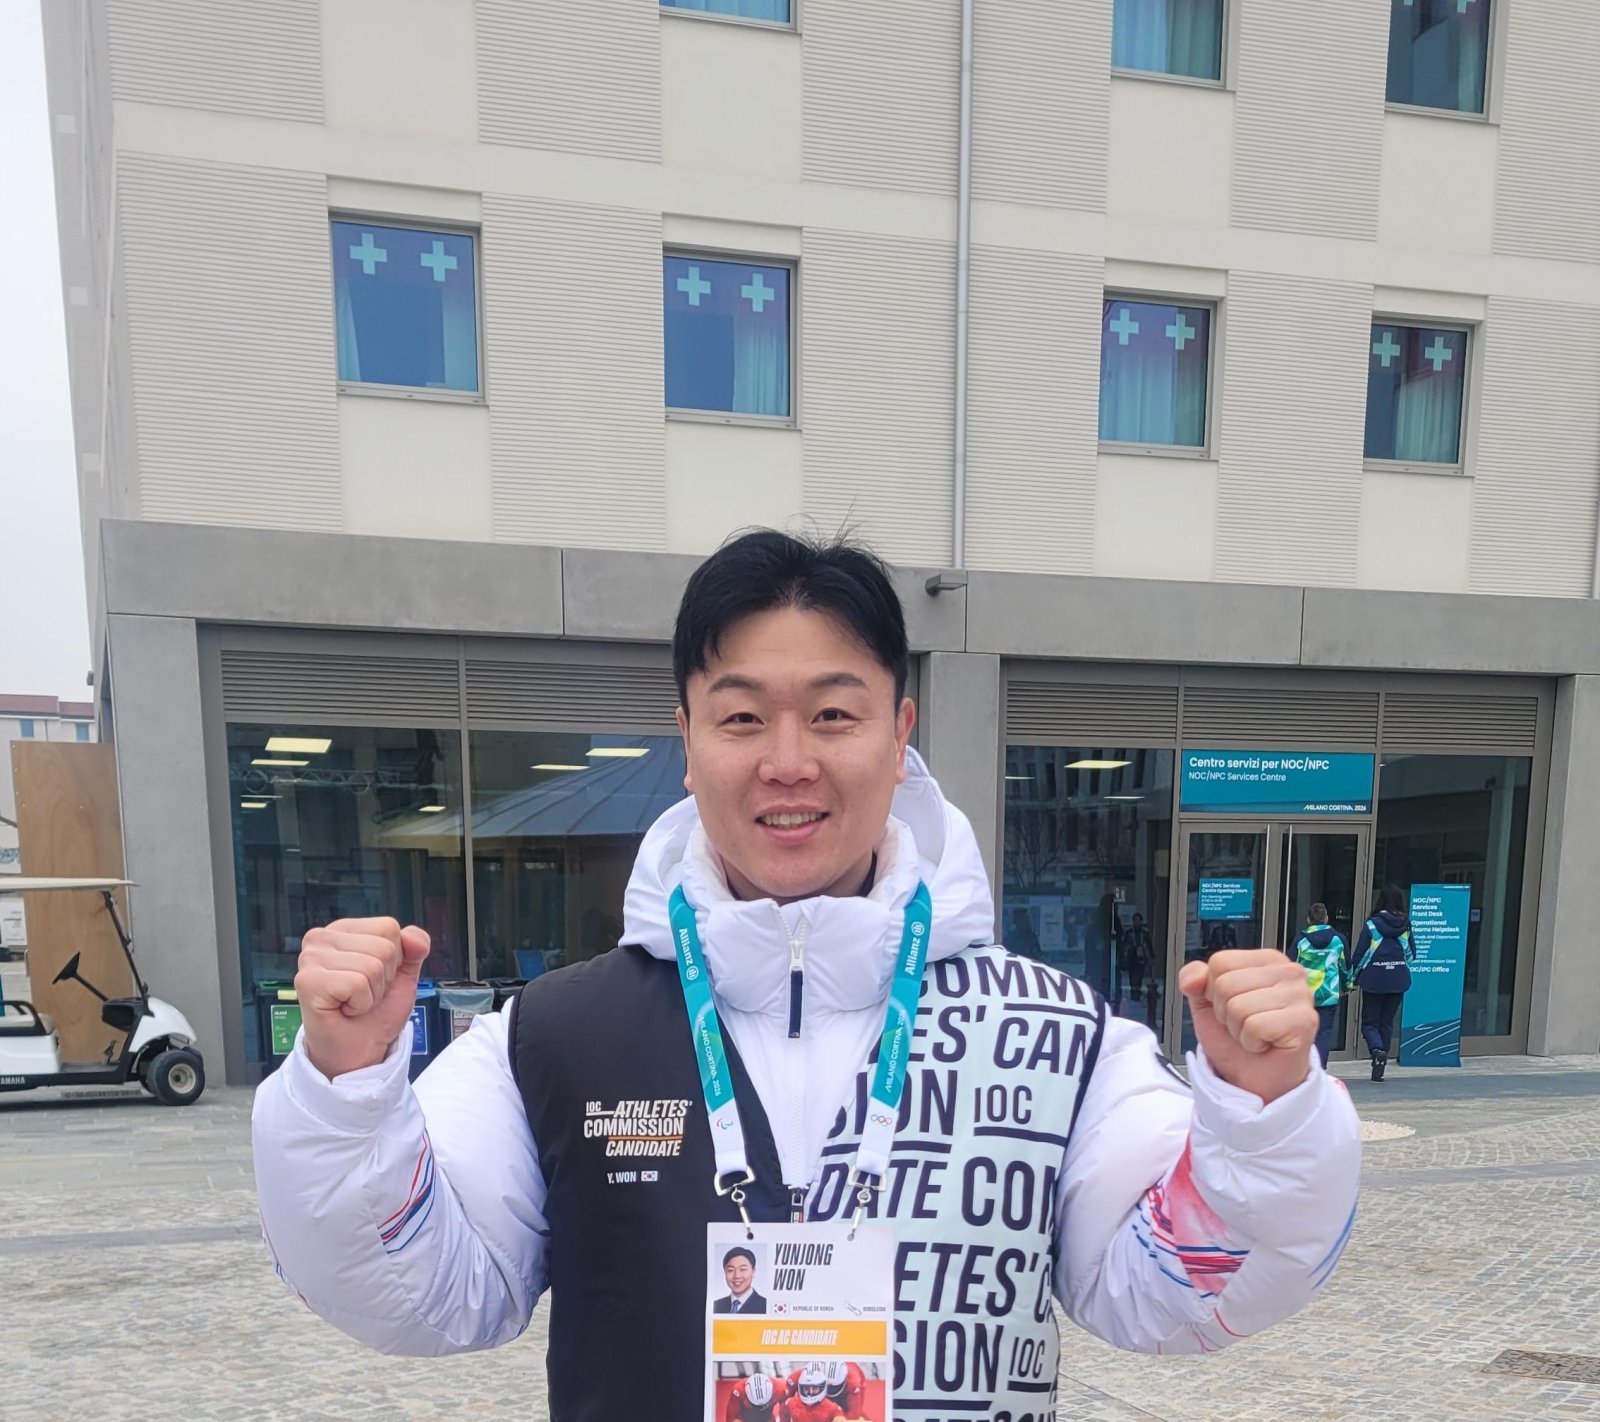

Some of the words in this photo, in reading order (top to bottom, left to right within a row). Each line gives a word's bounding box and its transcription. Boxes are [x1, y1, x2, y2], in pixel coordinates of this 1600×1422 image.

[1189, 757, 1226, 768] Centro
[1227, 758, 1260, 769] servizi
[1261, 760, 1280, 771] per
[1281, 757, 1330, 771] NOC/NPC
[1188, 770, 1226, 781] NOC/NPC
[1227, 771, 1259, 781] Services
[1260, 772, 1287, 782] Centre
[1432, 926, 1460, 934] Helpdesk
[679, 928, 694, 966] Allianz
[904, 937, 922, 976] Allianz
[586, 1101, 602, 1113] IOC
[613, 1099, 693, 1119] ATHLETES'
[973, 1083, 1033, 1125] IOC
[583, 1117, 684, 1139] COMMISSION
[605, 1140, 682, 1157] CANDIDATE
[607, 1172, 615, 1184] Y.
[615, 1171, 637, 1183] WON
[807, 1158, 948, 1223] DATE
[774, 1243, 834, 1266] YUNJONG
[772, 1268, 806, 1291] WON
[791, 1329, 839, 1346] CANDIDATE
[1009, 1337, 1045, 1380] IOC
